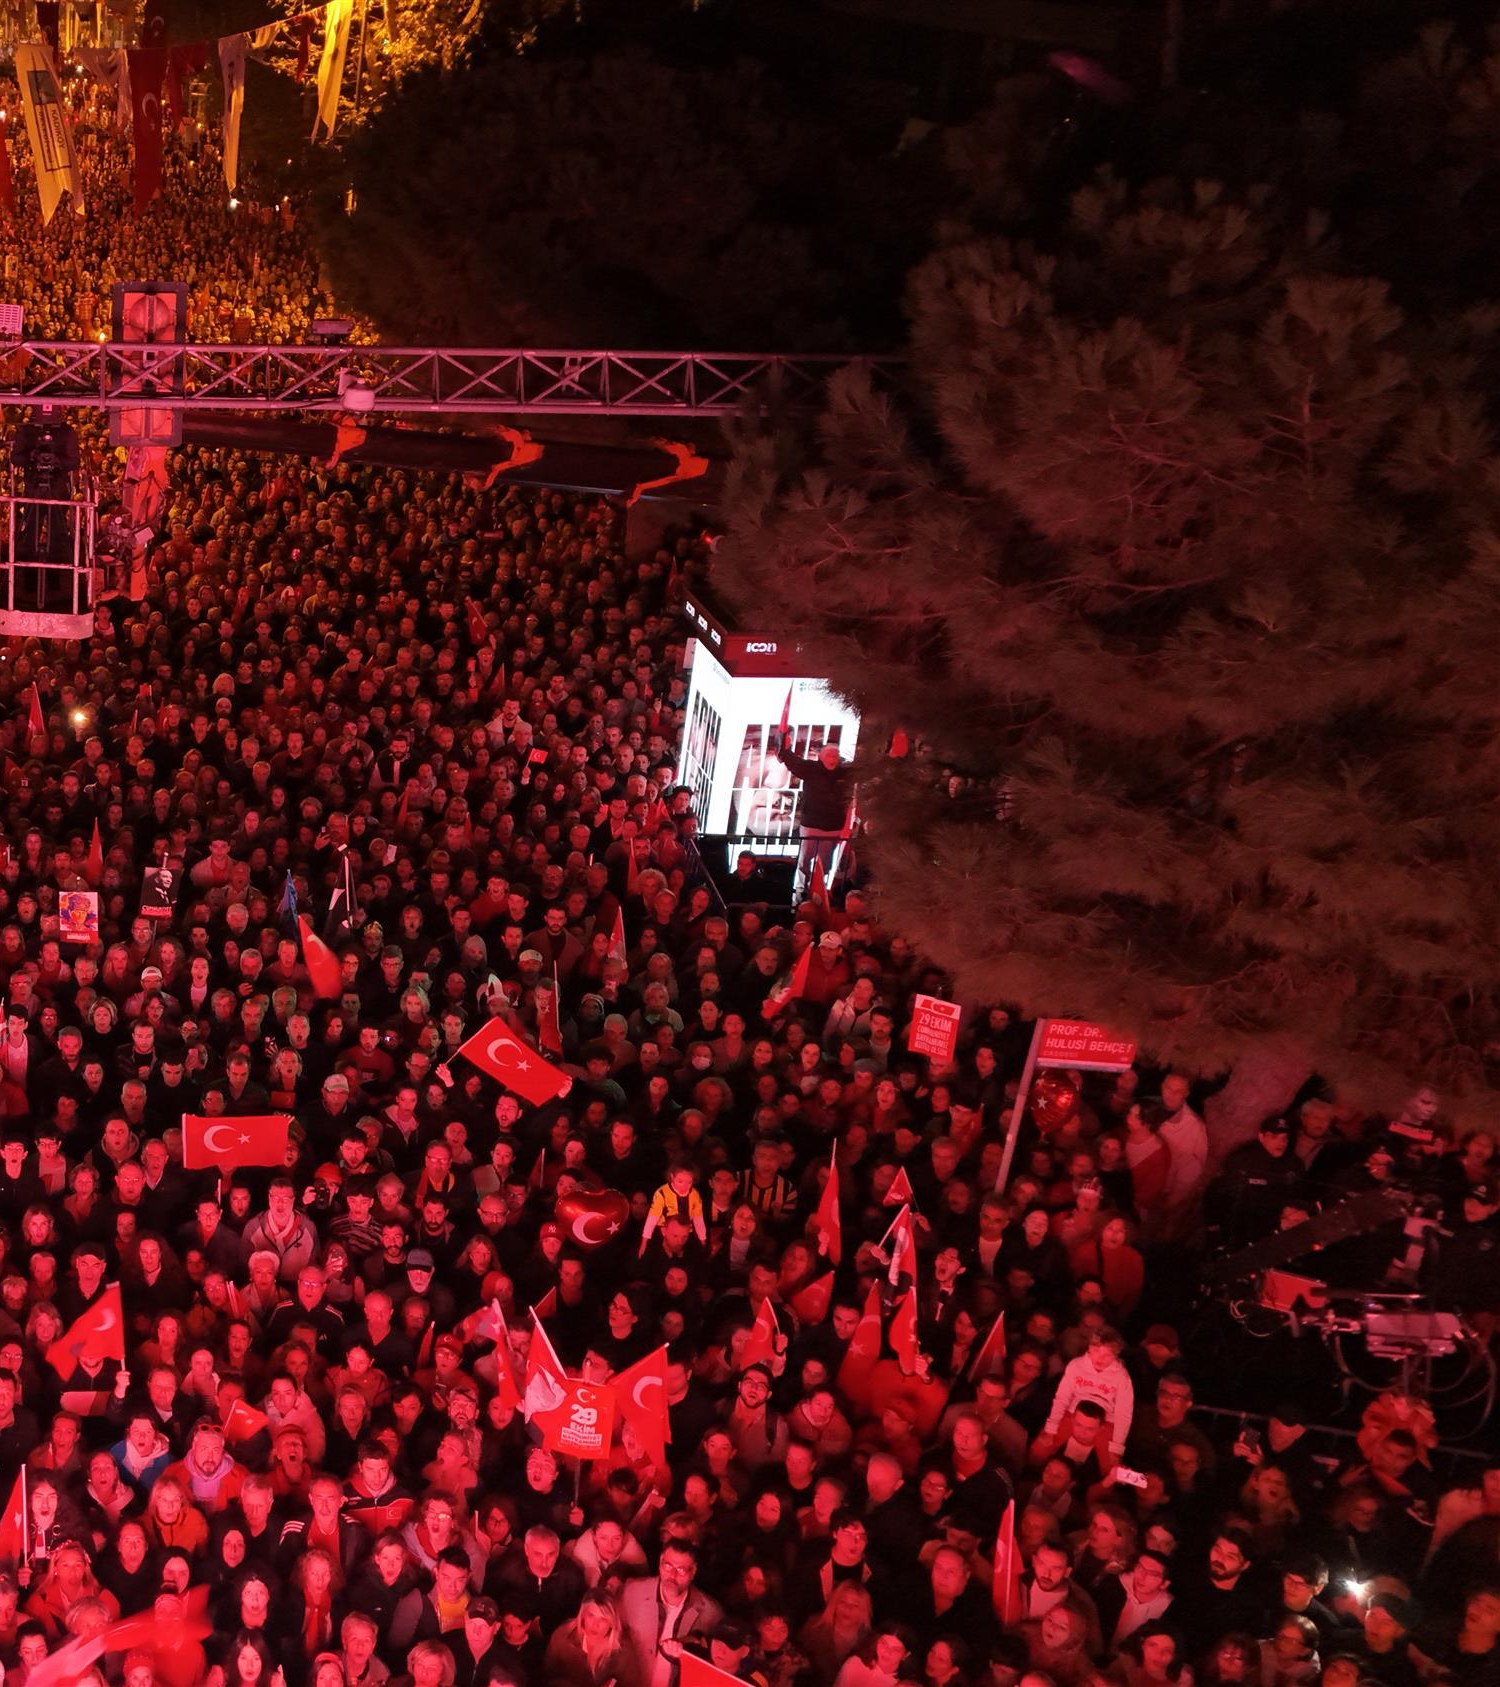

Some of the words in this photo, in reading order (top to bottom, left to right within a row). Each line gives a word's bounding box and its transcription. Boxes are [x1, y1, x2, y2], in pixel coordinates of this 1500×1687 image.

[919, 1012, 931, 1026] 29
[930, 1016, 953, 1033] EKİM
[1046, 1037, 1088, 1050] HULUSİ
[1089, 1041, 1134, 1054] BEHÇET
[570, 1403, 598, 1425] 29
[570, 1421, 596, 1434] EKİM
